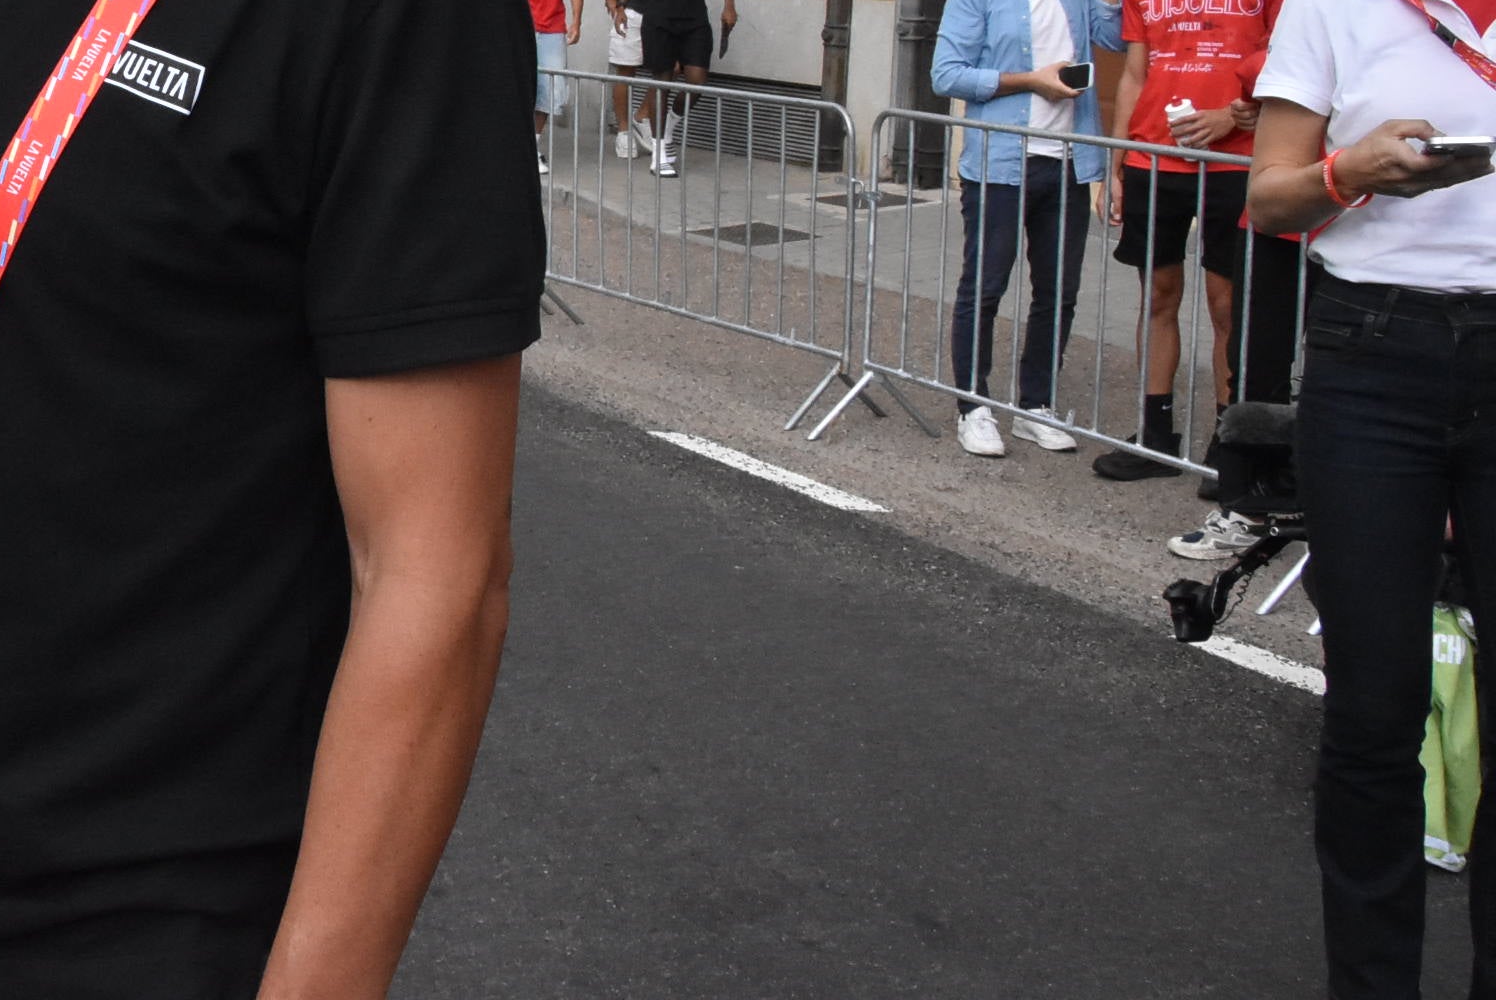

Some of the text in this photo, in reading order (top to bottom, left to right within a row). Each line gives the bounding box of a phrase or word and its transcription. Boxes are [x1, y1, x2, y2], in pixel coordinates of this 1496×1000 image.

[71, 28, 111, 81] LA VUELTA
[112, 50, 190, 101] VUELTA
[6, 139, 44, 195] LA VUELTA
